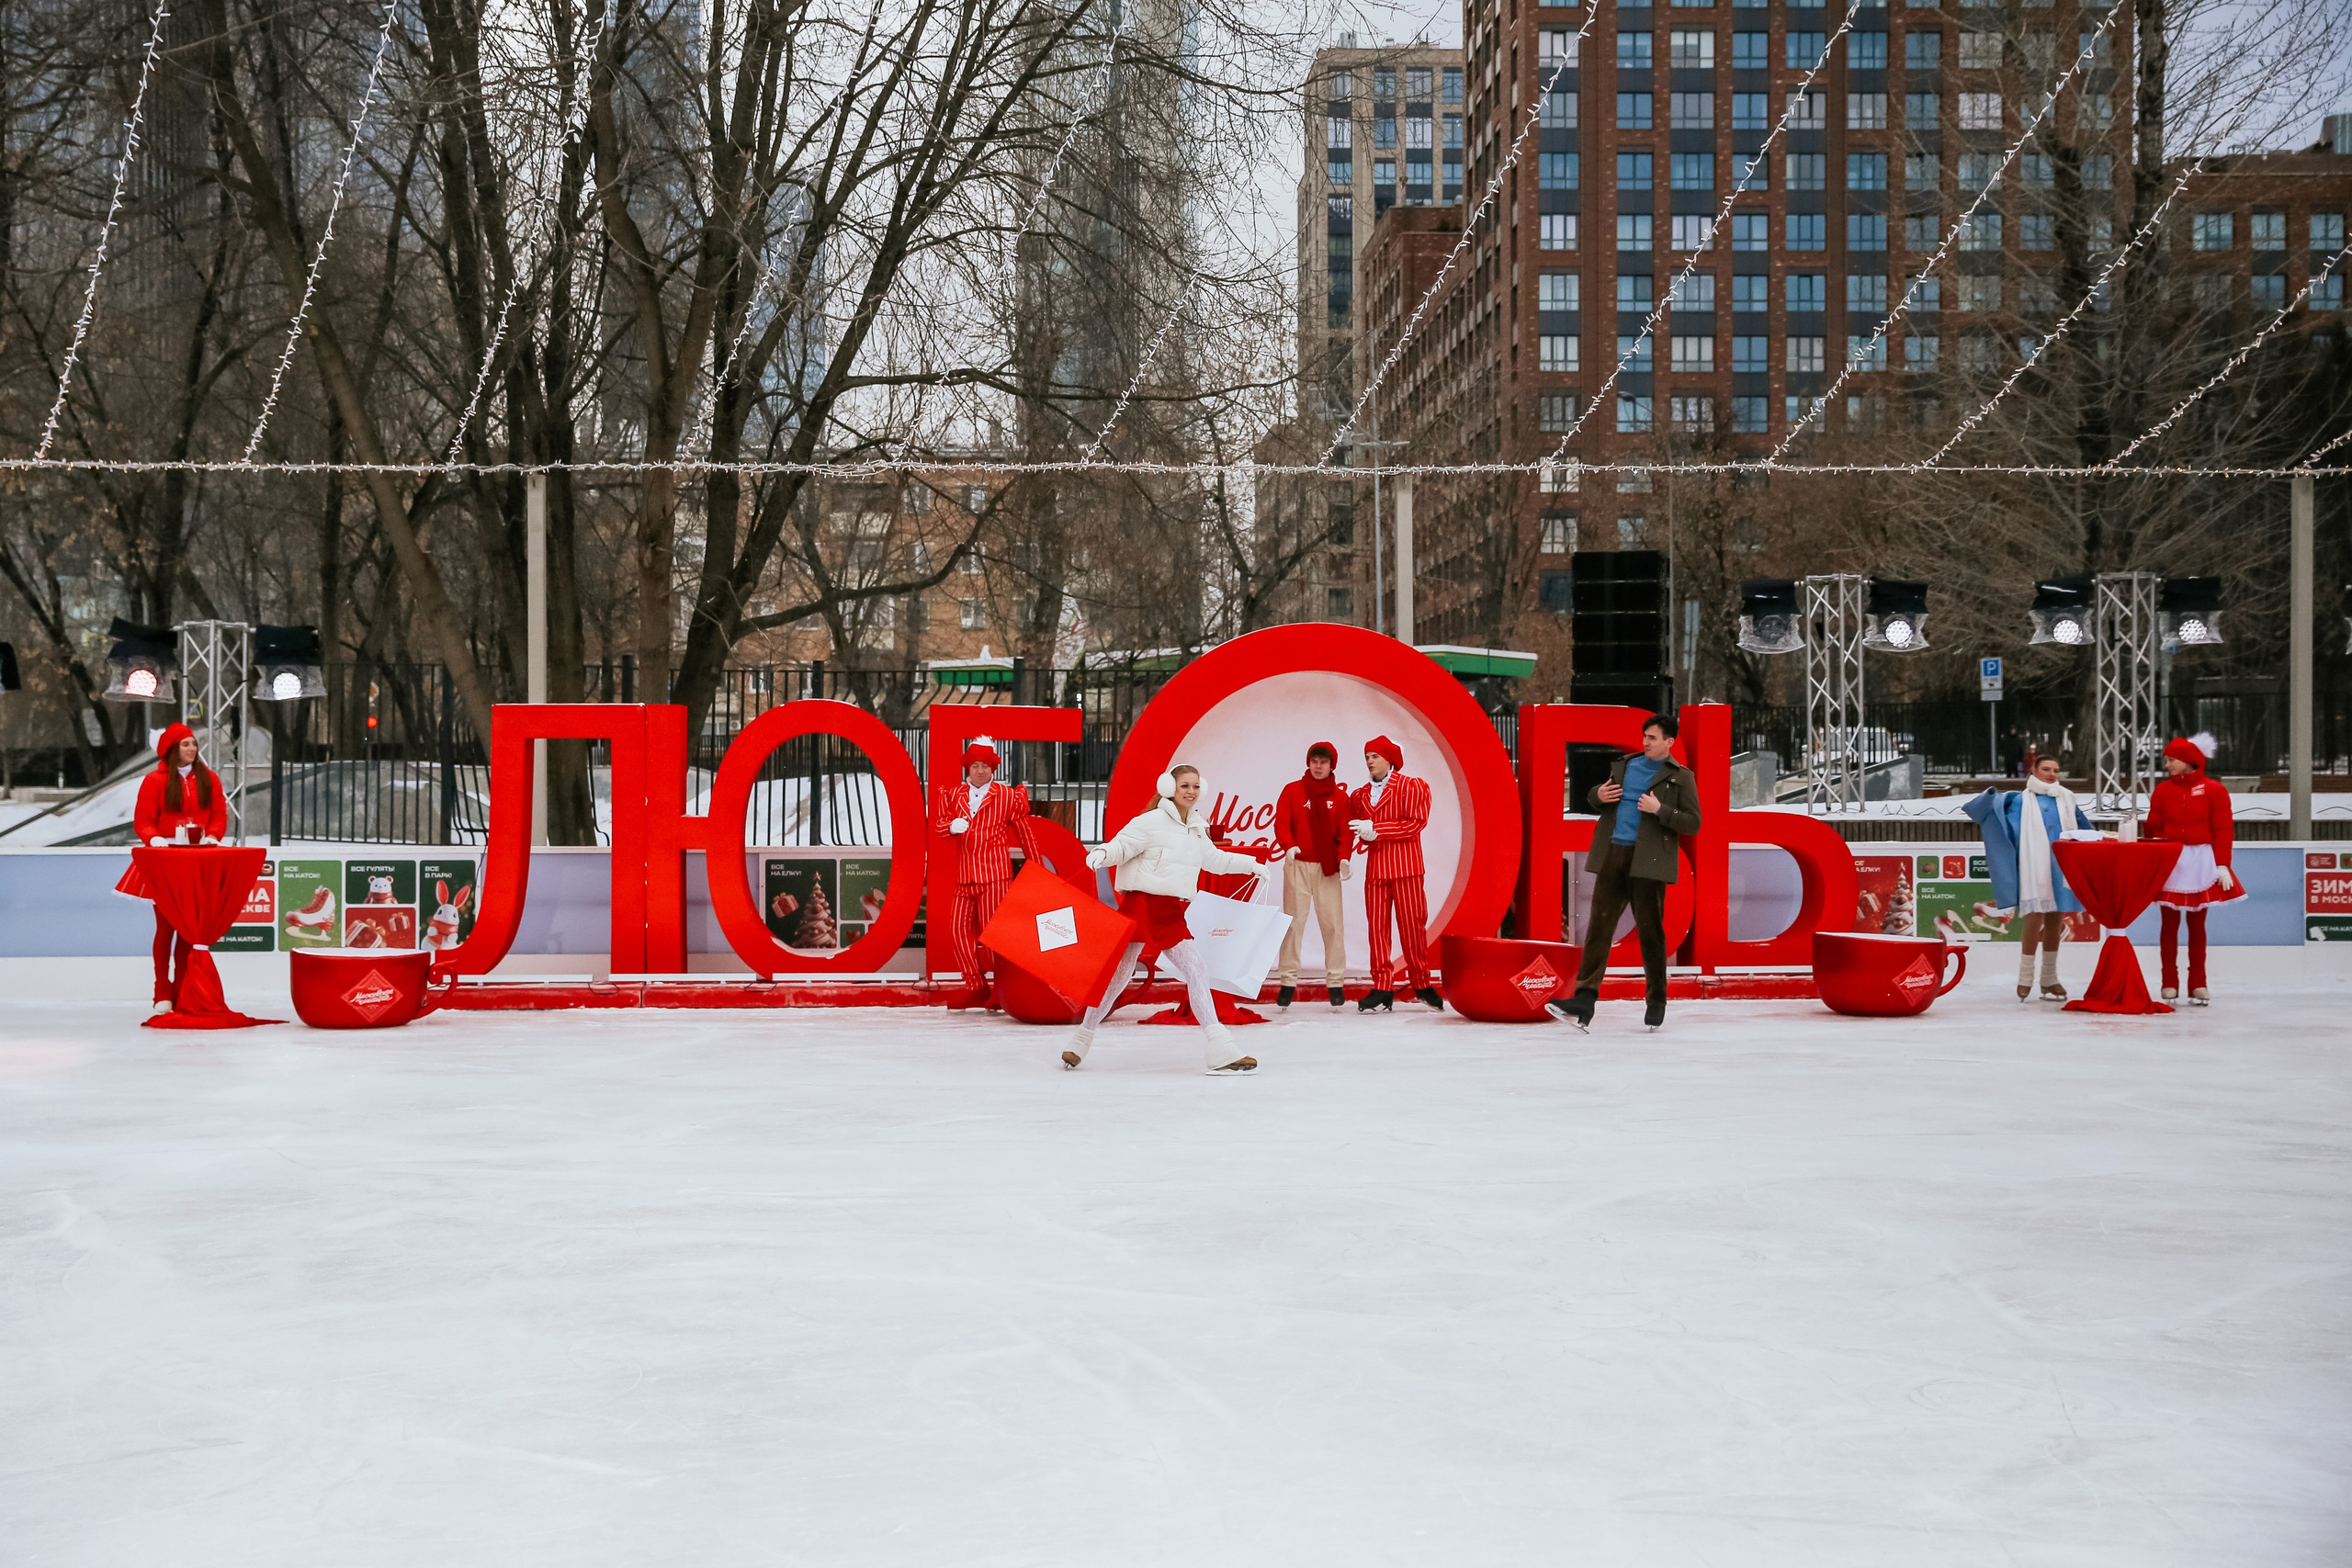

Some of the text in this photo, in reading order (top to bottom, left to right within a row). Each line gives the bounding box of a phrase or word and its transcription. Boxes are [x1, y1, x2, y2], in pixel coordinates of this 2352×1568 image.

[1986, 661, 1996, 675] P
[435, 625, 1858, 979] ЛЮБОВЬ
[2311, 879, 2352, 894] ЗИМ
[2311, 895, 2352, 904] В МОС
[241, 904, 271, 913] КВЕ
